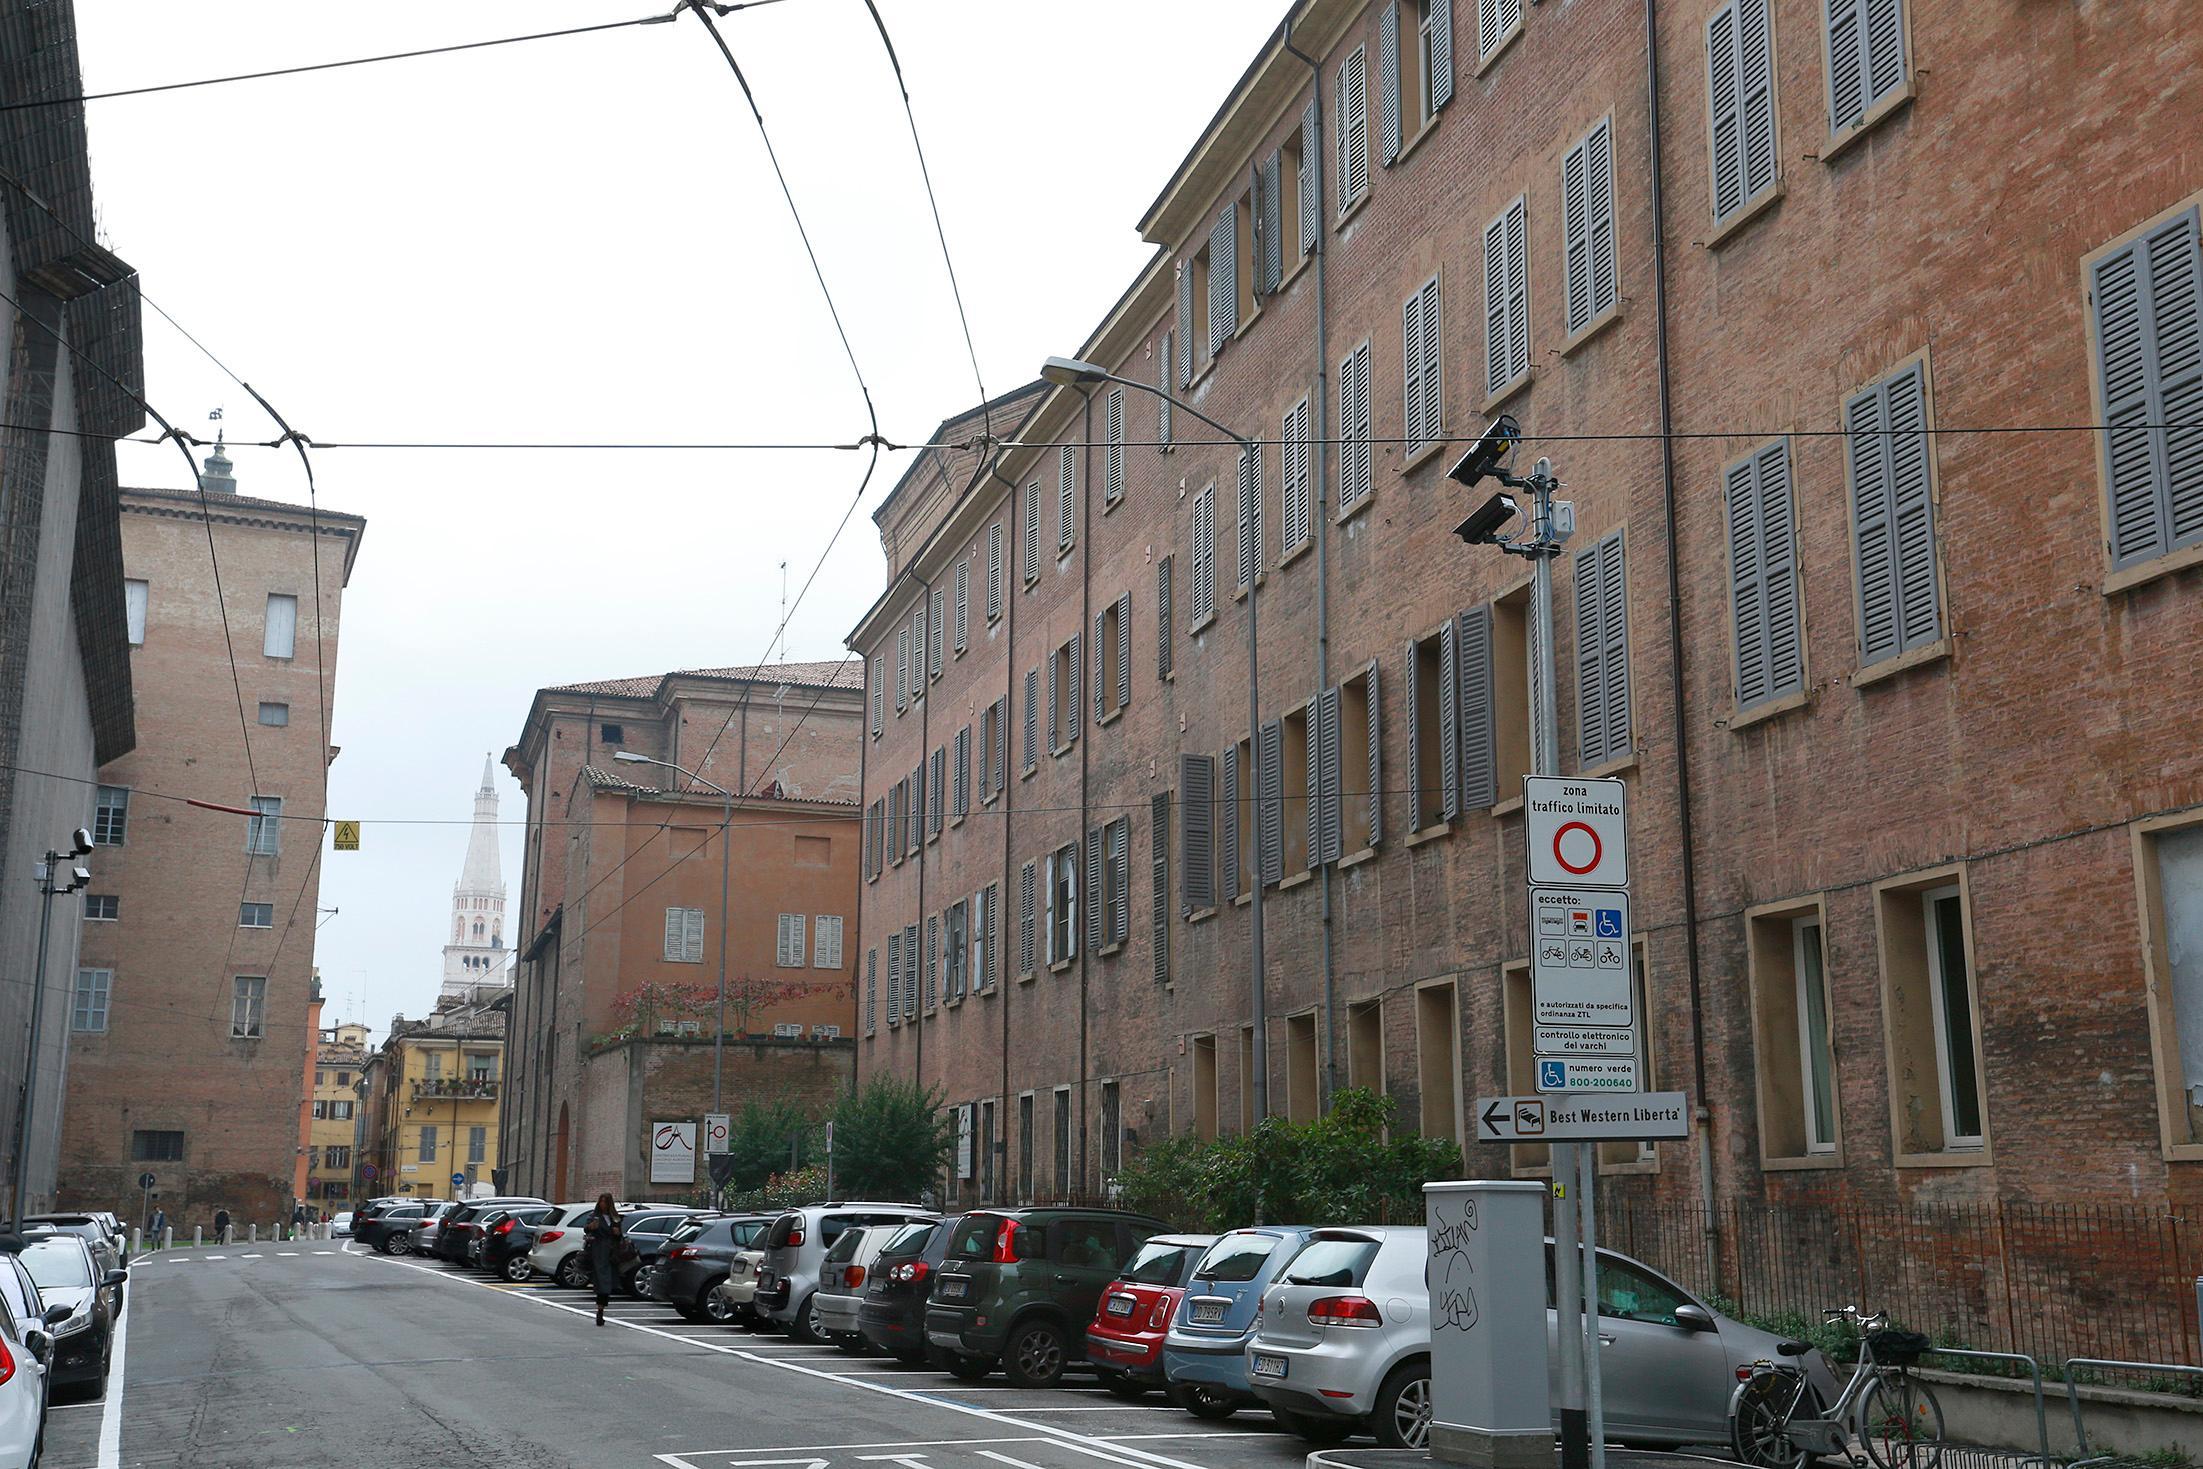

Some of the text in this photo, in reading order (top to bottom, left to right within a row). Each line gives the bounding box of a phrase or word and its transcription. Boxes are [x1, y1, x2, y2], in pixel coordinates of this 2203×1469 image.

[1563, 787, 1587, 796] zona
[1533, 800, 1620, 815] traffico limitato
[1538, 896, 1581, 905] eccetto:
[1596, 1003, 1628, 1011] specifica
[1540, 1032, 1630, 1041] controllo elettronico
[1580, 1042, 1607, 1050] varchi
[1607, 1065, 1632, 1073] verde
[1550, 1107, 1680, 1123] Best Western Liberta'
